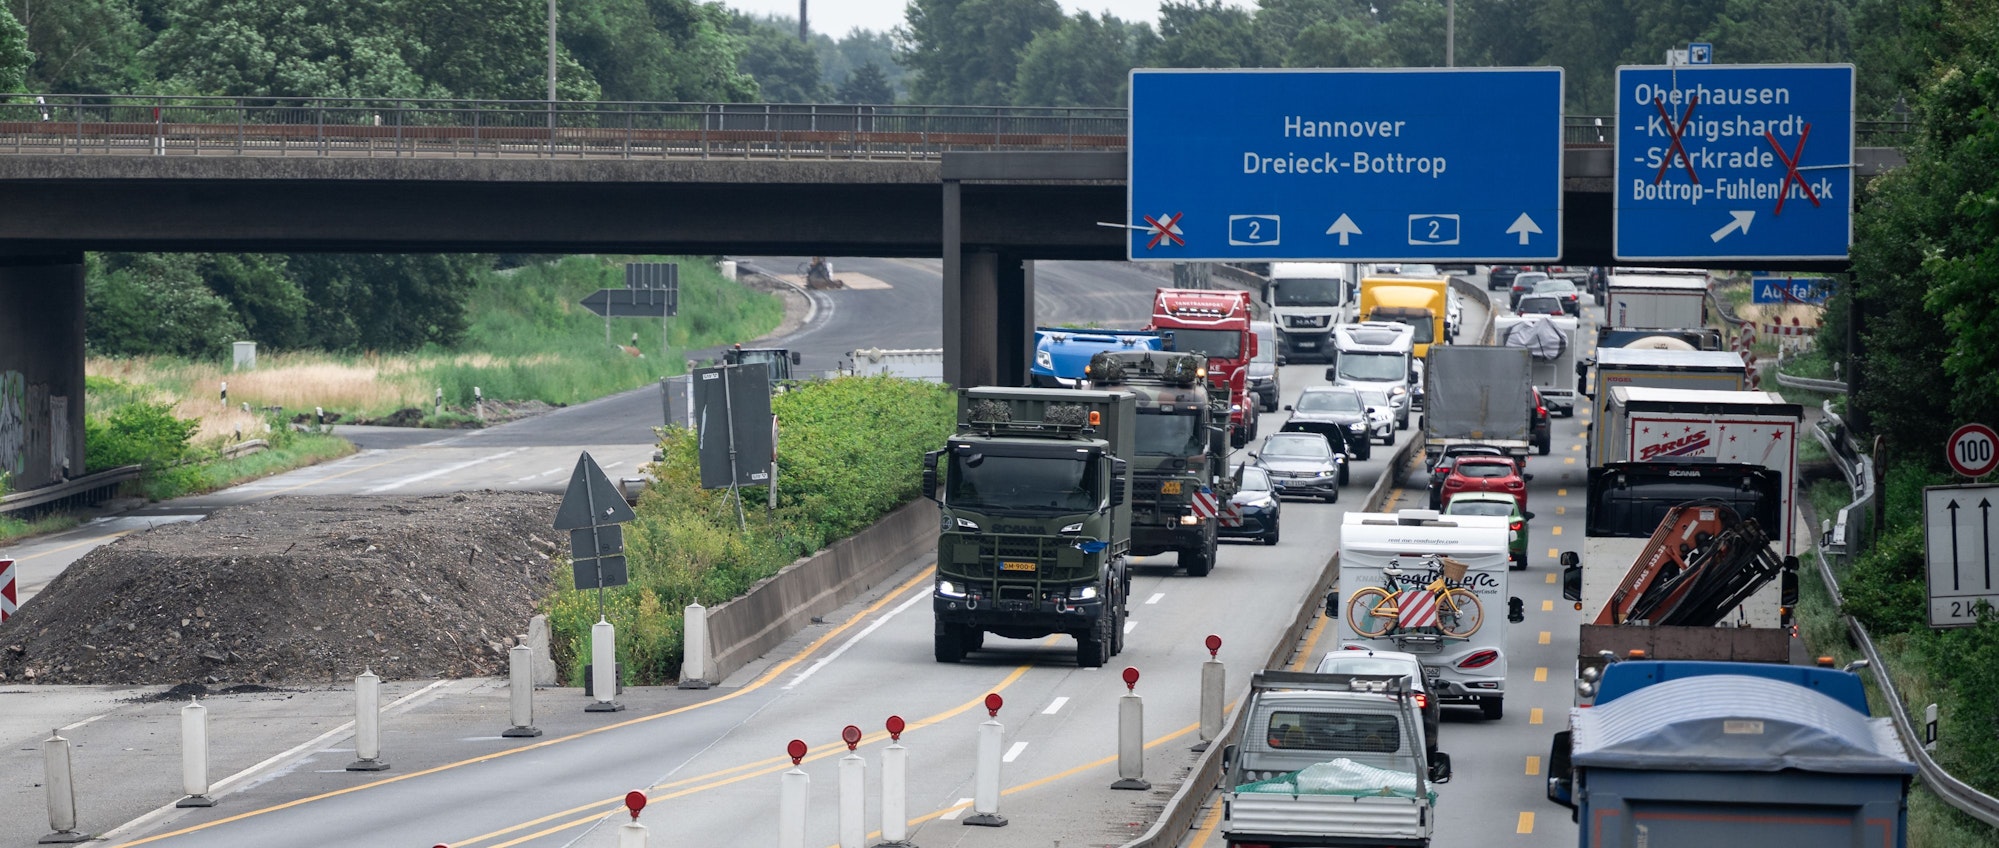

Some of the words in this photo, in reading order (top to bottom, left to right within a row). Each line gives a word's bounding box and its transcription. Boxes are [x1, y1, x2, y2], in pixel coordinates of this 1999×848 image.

[1635, 83, 1789, 105] Oberhausen
[1284, 115, 1406, 138] Hannover
[1243, 151, 1447, 179] Dreieck-Bottrop
[1634, 146, 1774, 169] -Serkrade
[1249, 221, 1260, 239] 2
[1428, 220, 1440, 239] 2
[1958, 438, 1991, 462] 100
[991, 523, 1048, 535] SCANIA
[1633, 569, 1650, 591] ATLAS
[1951, 602, 1962, 618] 2
